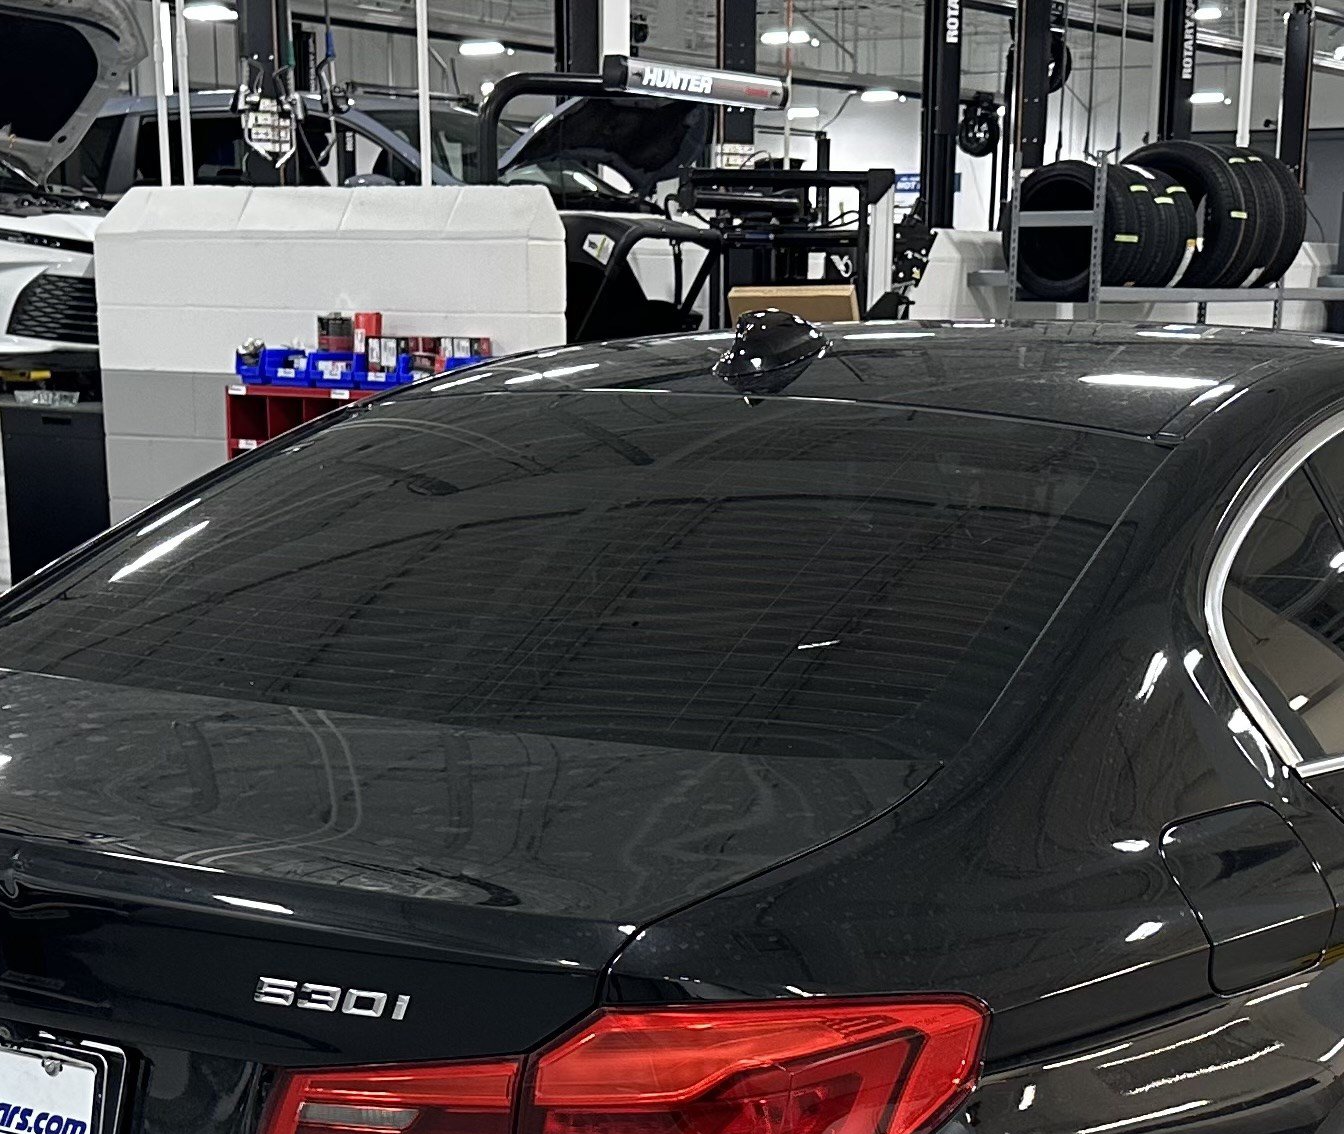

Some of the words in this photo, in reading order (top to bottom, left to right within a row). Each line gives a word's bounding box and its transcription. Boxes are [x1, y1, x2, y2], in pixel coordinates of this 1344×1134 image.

[1182, 19, 1194, 79] ROTARY
[642, 66, 713, 94] HUNTER
[253, 976, 411, 1020] 530i
